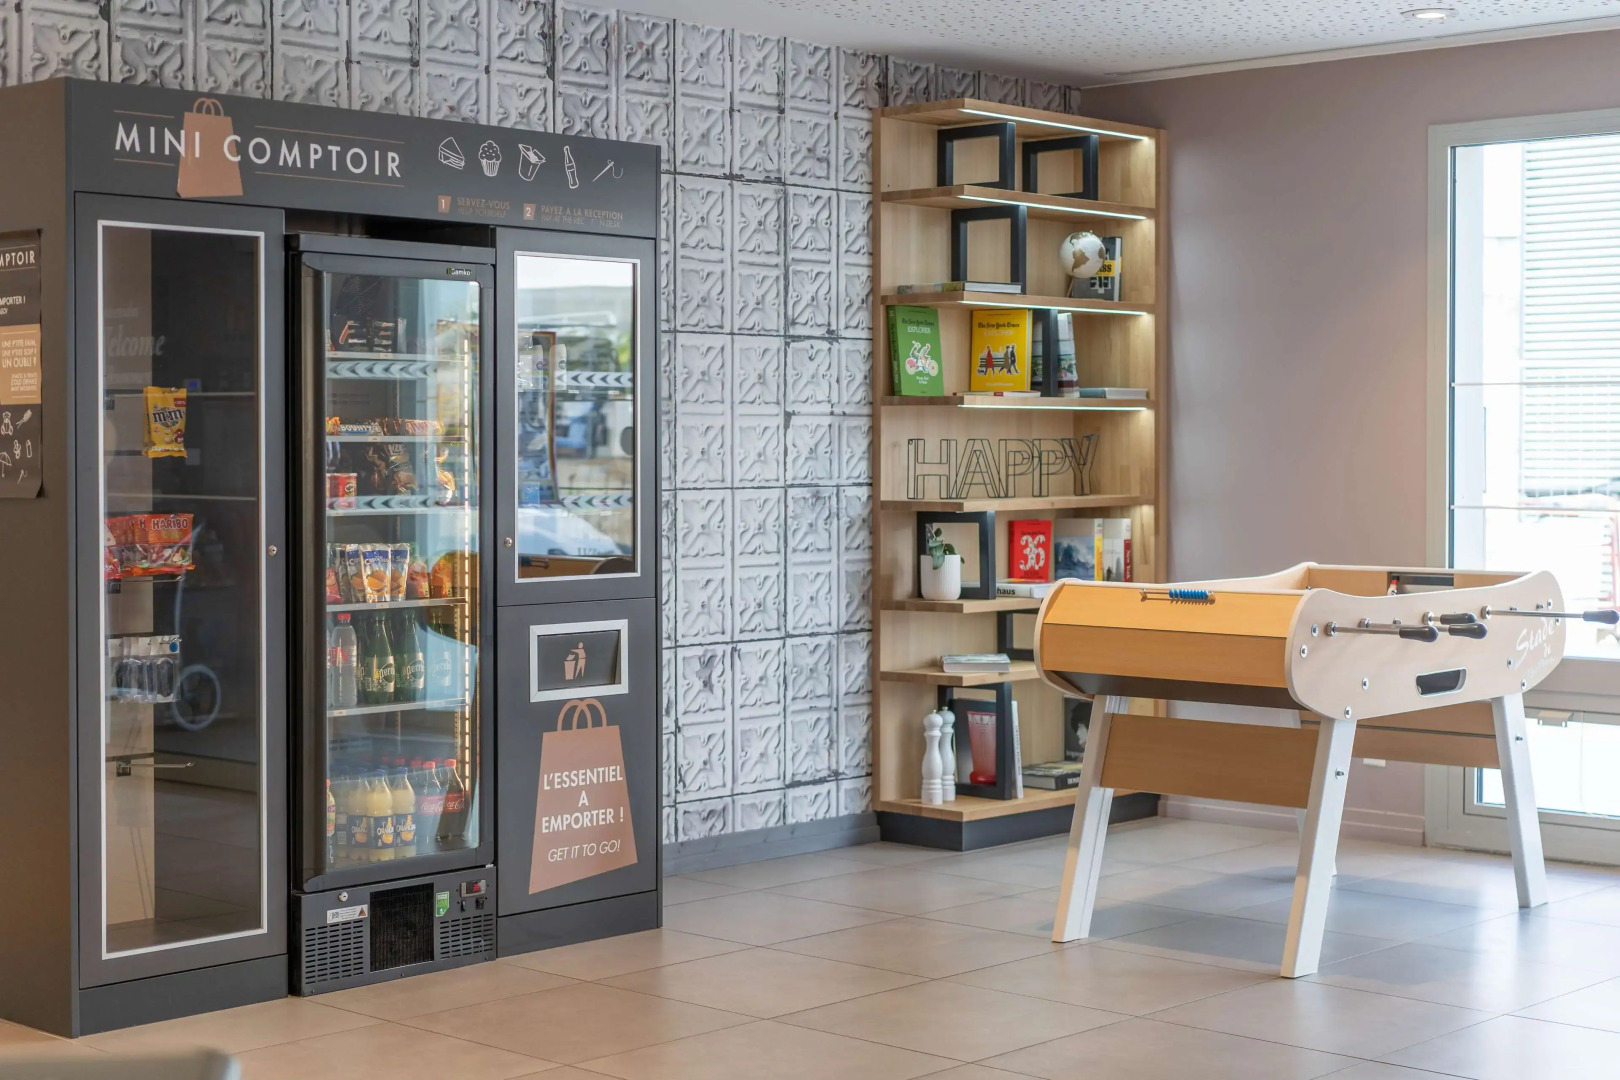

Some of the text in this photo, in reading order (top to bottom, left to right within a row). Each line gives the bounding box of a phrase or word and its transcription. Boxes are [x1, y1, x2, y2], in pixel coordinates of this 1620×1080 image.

[115, 122, 402, 178] MINI COMPTOIR
[457, 197, 511, 210] SERVEZ-VOUS
[525, 205, 623, 220] 2 PAYEZ A LA RECEPTION
[340, 424, 372, 432] BOUNTY
[907, 433, 1100, 500] HAPPY
[152, 517, 189, 531] HARIBO
[1019, 534, 1046, 571] 36
[543, 765, 623, 790] L'ESSENTIEL
[578, 790, 589, 807] A
[542, 806, 624, 834] EMPORTER !
[548, 839, 621, 862] GET IT TO GO!
